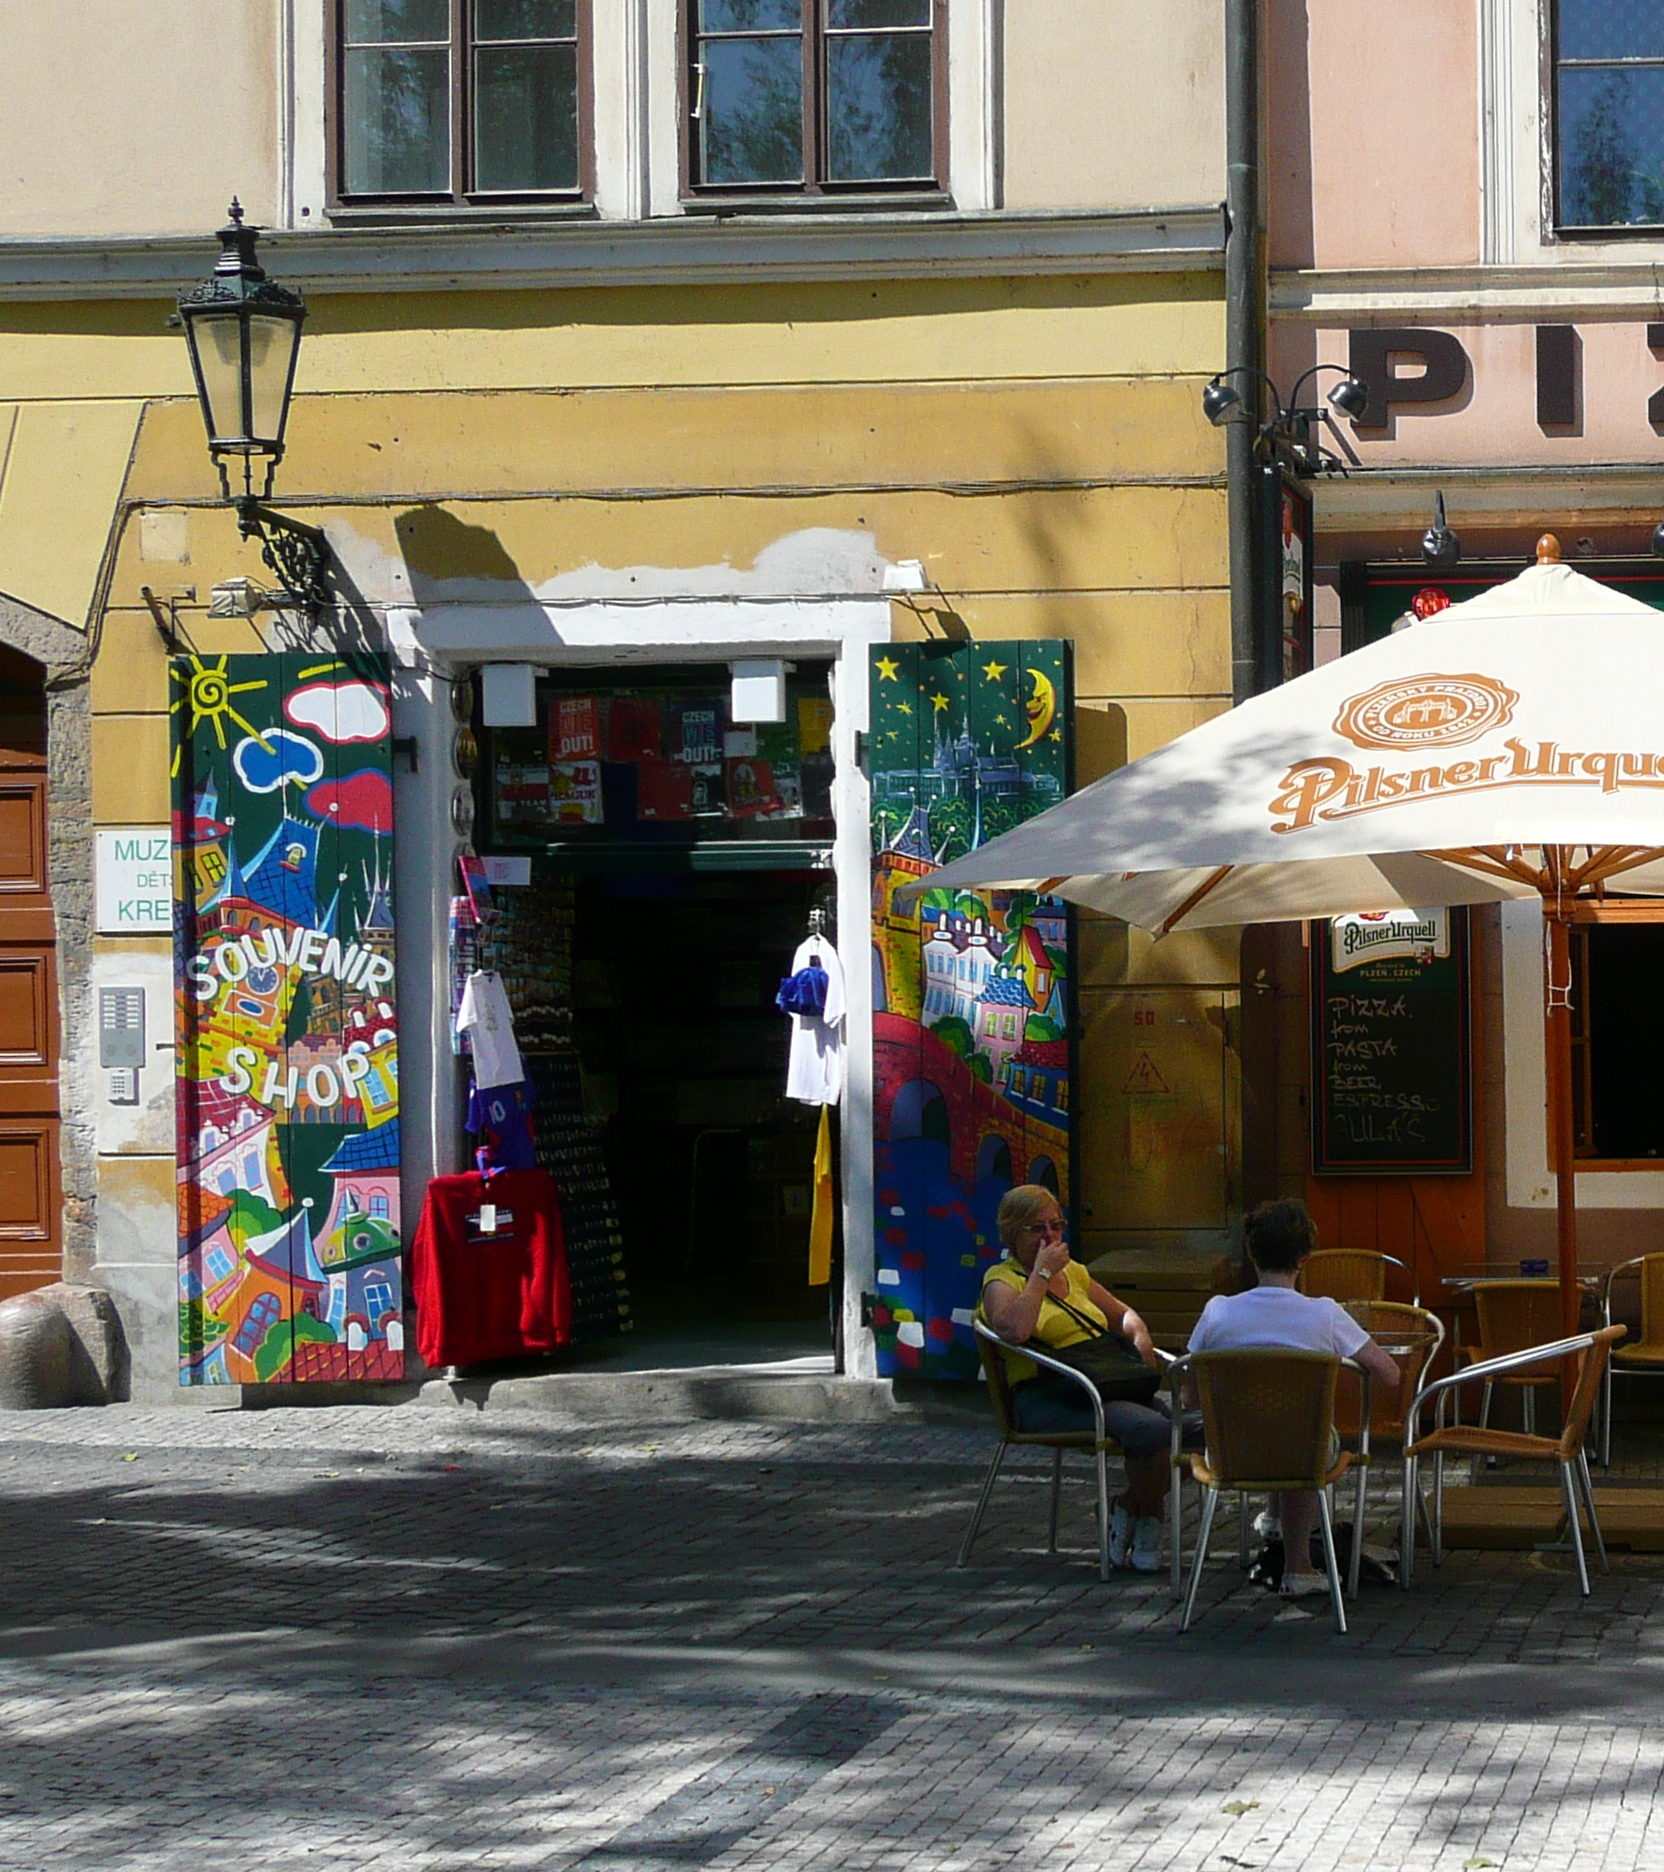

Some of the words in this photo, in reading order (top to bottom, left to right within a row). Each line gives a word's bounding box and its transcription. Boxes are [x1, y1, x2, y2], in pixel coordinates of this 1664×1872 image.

[1372, 725, 1390, 736] OD
[1390, 731, 1435, 739] ROKU
[1267, 755, 1510, 835] Pilsner
[114, 838, 172, 861] MUZ
[1343, 921, 1391, 955] Pilsner
[1390, 919, 1437, 945] Urquell
[1326, 1037, 1398, 1059] PASTA
[218, 1046, 371, 1109] SHOP
[1327, 1075, 1382, 1090] BEER
[488, 1100, 507, 1125] 10
